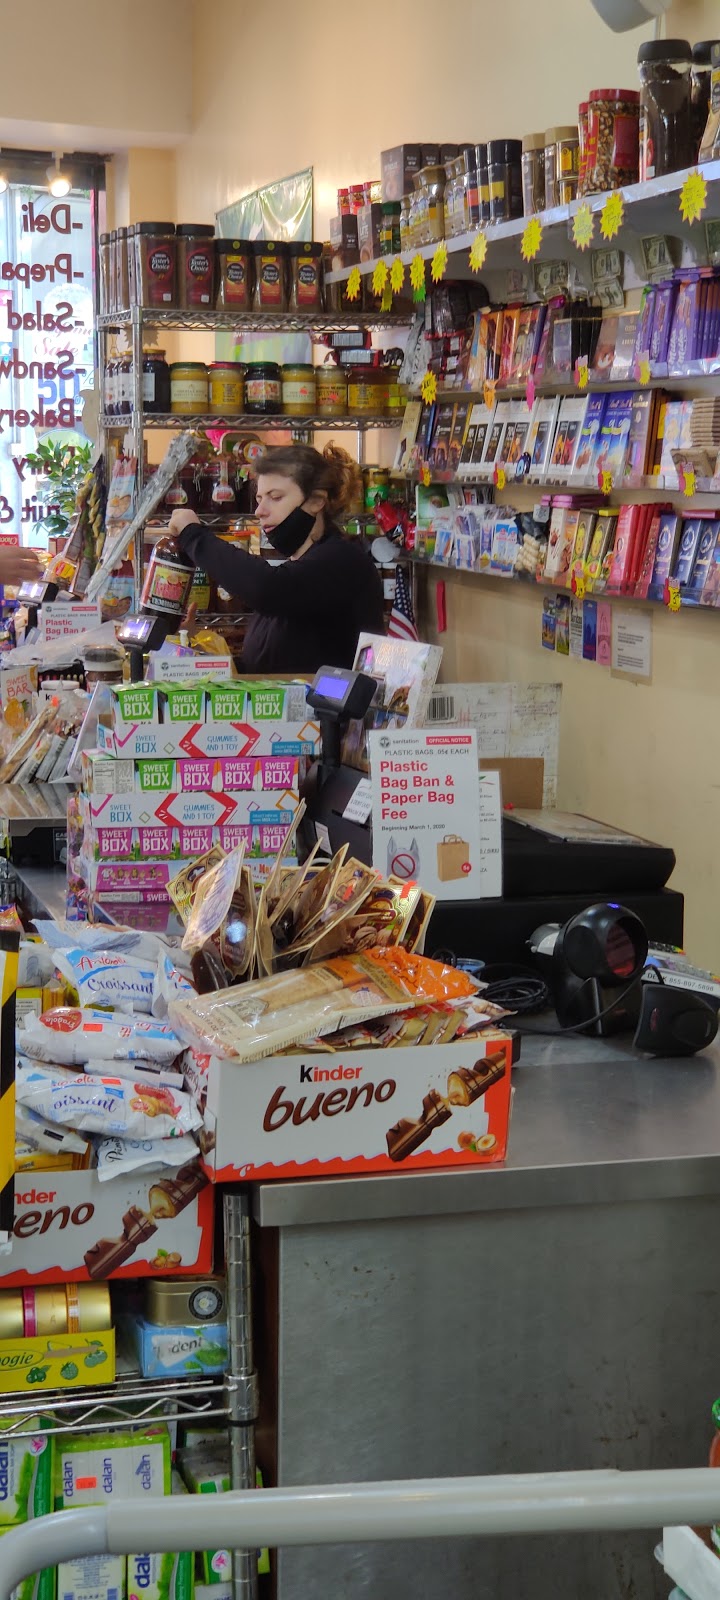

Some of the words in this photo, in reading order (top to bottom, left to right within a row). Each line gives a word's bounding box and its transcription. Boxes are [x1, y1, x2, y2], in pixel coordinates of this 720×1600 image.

[46, 627, 61, 635] Bag
[123, 693, 149, 702] SWEET
[172, 694, 198, 703] SWEET
[214, 694, 240, 702] SWEET
[255, 693, 280, 702] SWEET
[124, 703, 151, 716] BOX
[172, 703, 199, 716] BOX
[214, 703, 241, 716] BOX
[255, 702, 281, 716] BOX
[207, 735, 238, 743] GUMMIES
[135, 743, 157, 753] BOX
[143, 763, 168, 772] SWEET
[184, 763, 209, 772] SWEET
[225, 762, 250, 771] SWEET
[265, 762, 289, 771] SWEET
[380, 760, 428, 772] Plastic
[143, 773, 170, 786] BOX
[183, 773, 210, 786] BOX
[225, 772, 251, 785] BOX
[265, 771, 290, 784] BOX
[381, 776, 408, 790] Bag
[413, 775, 440, 787] Ban
[444, 775, 455, 786] &
[381, 792, 423, 805] Paper
[427, 791, 455, 804] Bag
[183, 804, 215, 812] GUMMIES
[381, 808, 408, 820] Fee
[110, 812, 132, 822] BOX
[202, 812, 215, 820] TOY
[101, 829, 128, 838] SWEET
[143, 829, 168, 838] SWEET
[183, 828, 208, 837] SWEET
[223, 828, 248, 837] SWEET
[102, 838, 129, 852] BOX
[143, 838, 169, 851] BOX
[183, 838, 209, 851] BOX
[647, 972, 667, 982] DEK
[87, 977, 154, 996] Croissant
[53, 1094, 118, 1113] oissant
[263, 1078, 397, 1132] bueno
[14, 1188, 57, 1205] nder
[13, 1202, 95, 1239] eno
[0, 1351, 34, 1368] ogie
[63, 1460, 74, 1497] dalan
[102, 1457, 113, 1494] dalan
